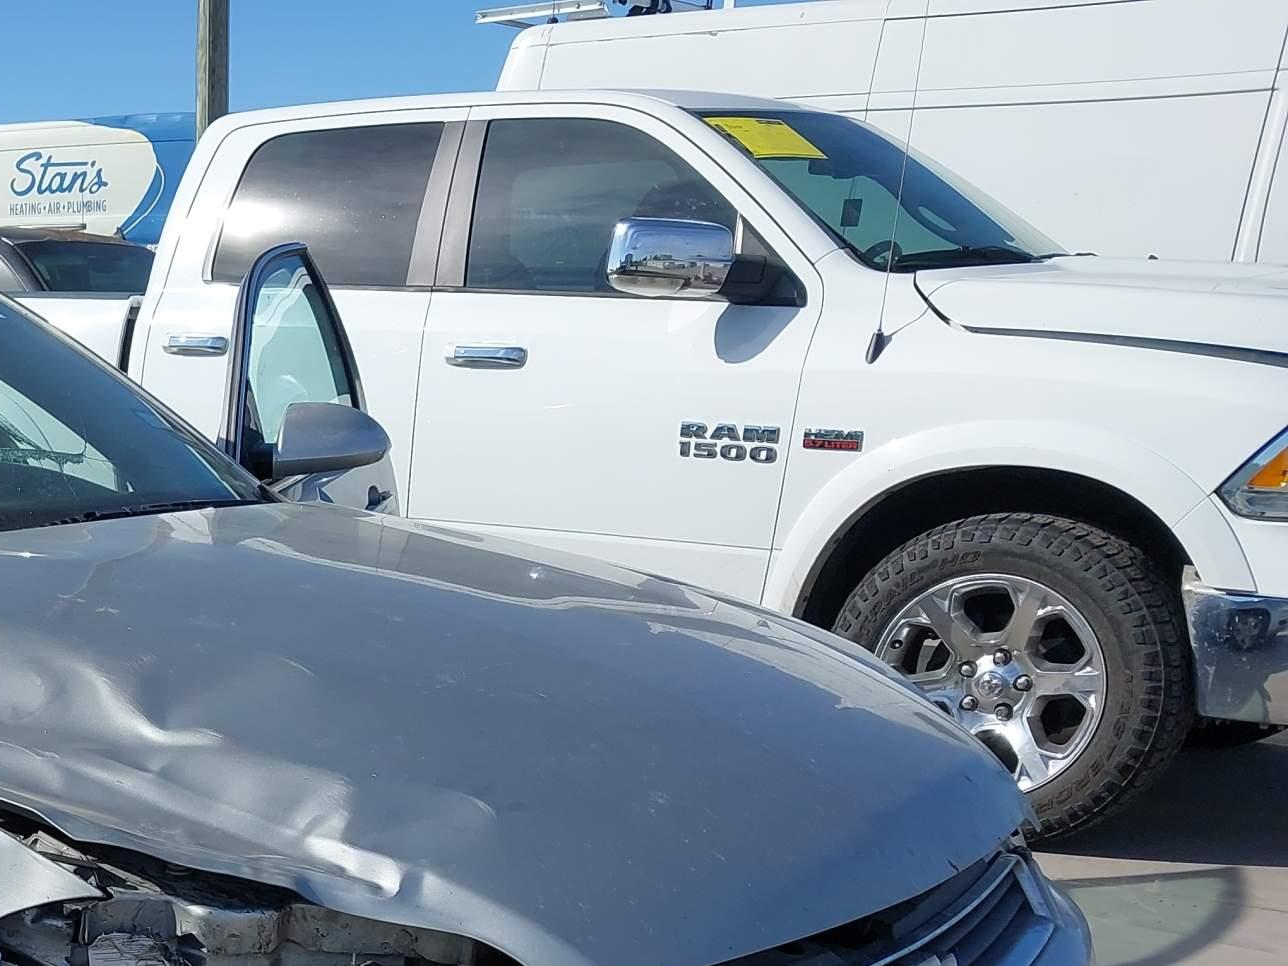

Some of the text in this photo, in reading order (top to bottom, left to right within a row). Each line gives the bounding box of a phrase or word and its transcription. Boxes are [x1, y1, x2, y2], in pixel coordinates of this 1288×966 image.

[9, 151, 109, 197] Stan's
[9, 199, 107, 216] HEATING AIR PLUMBING
[680, 421, 780, 443] RAM
[803, 427, 864, 442] HEMI
[679, 441, 778, 464] 1500
[824, 440, 858, 450] LITER
